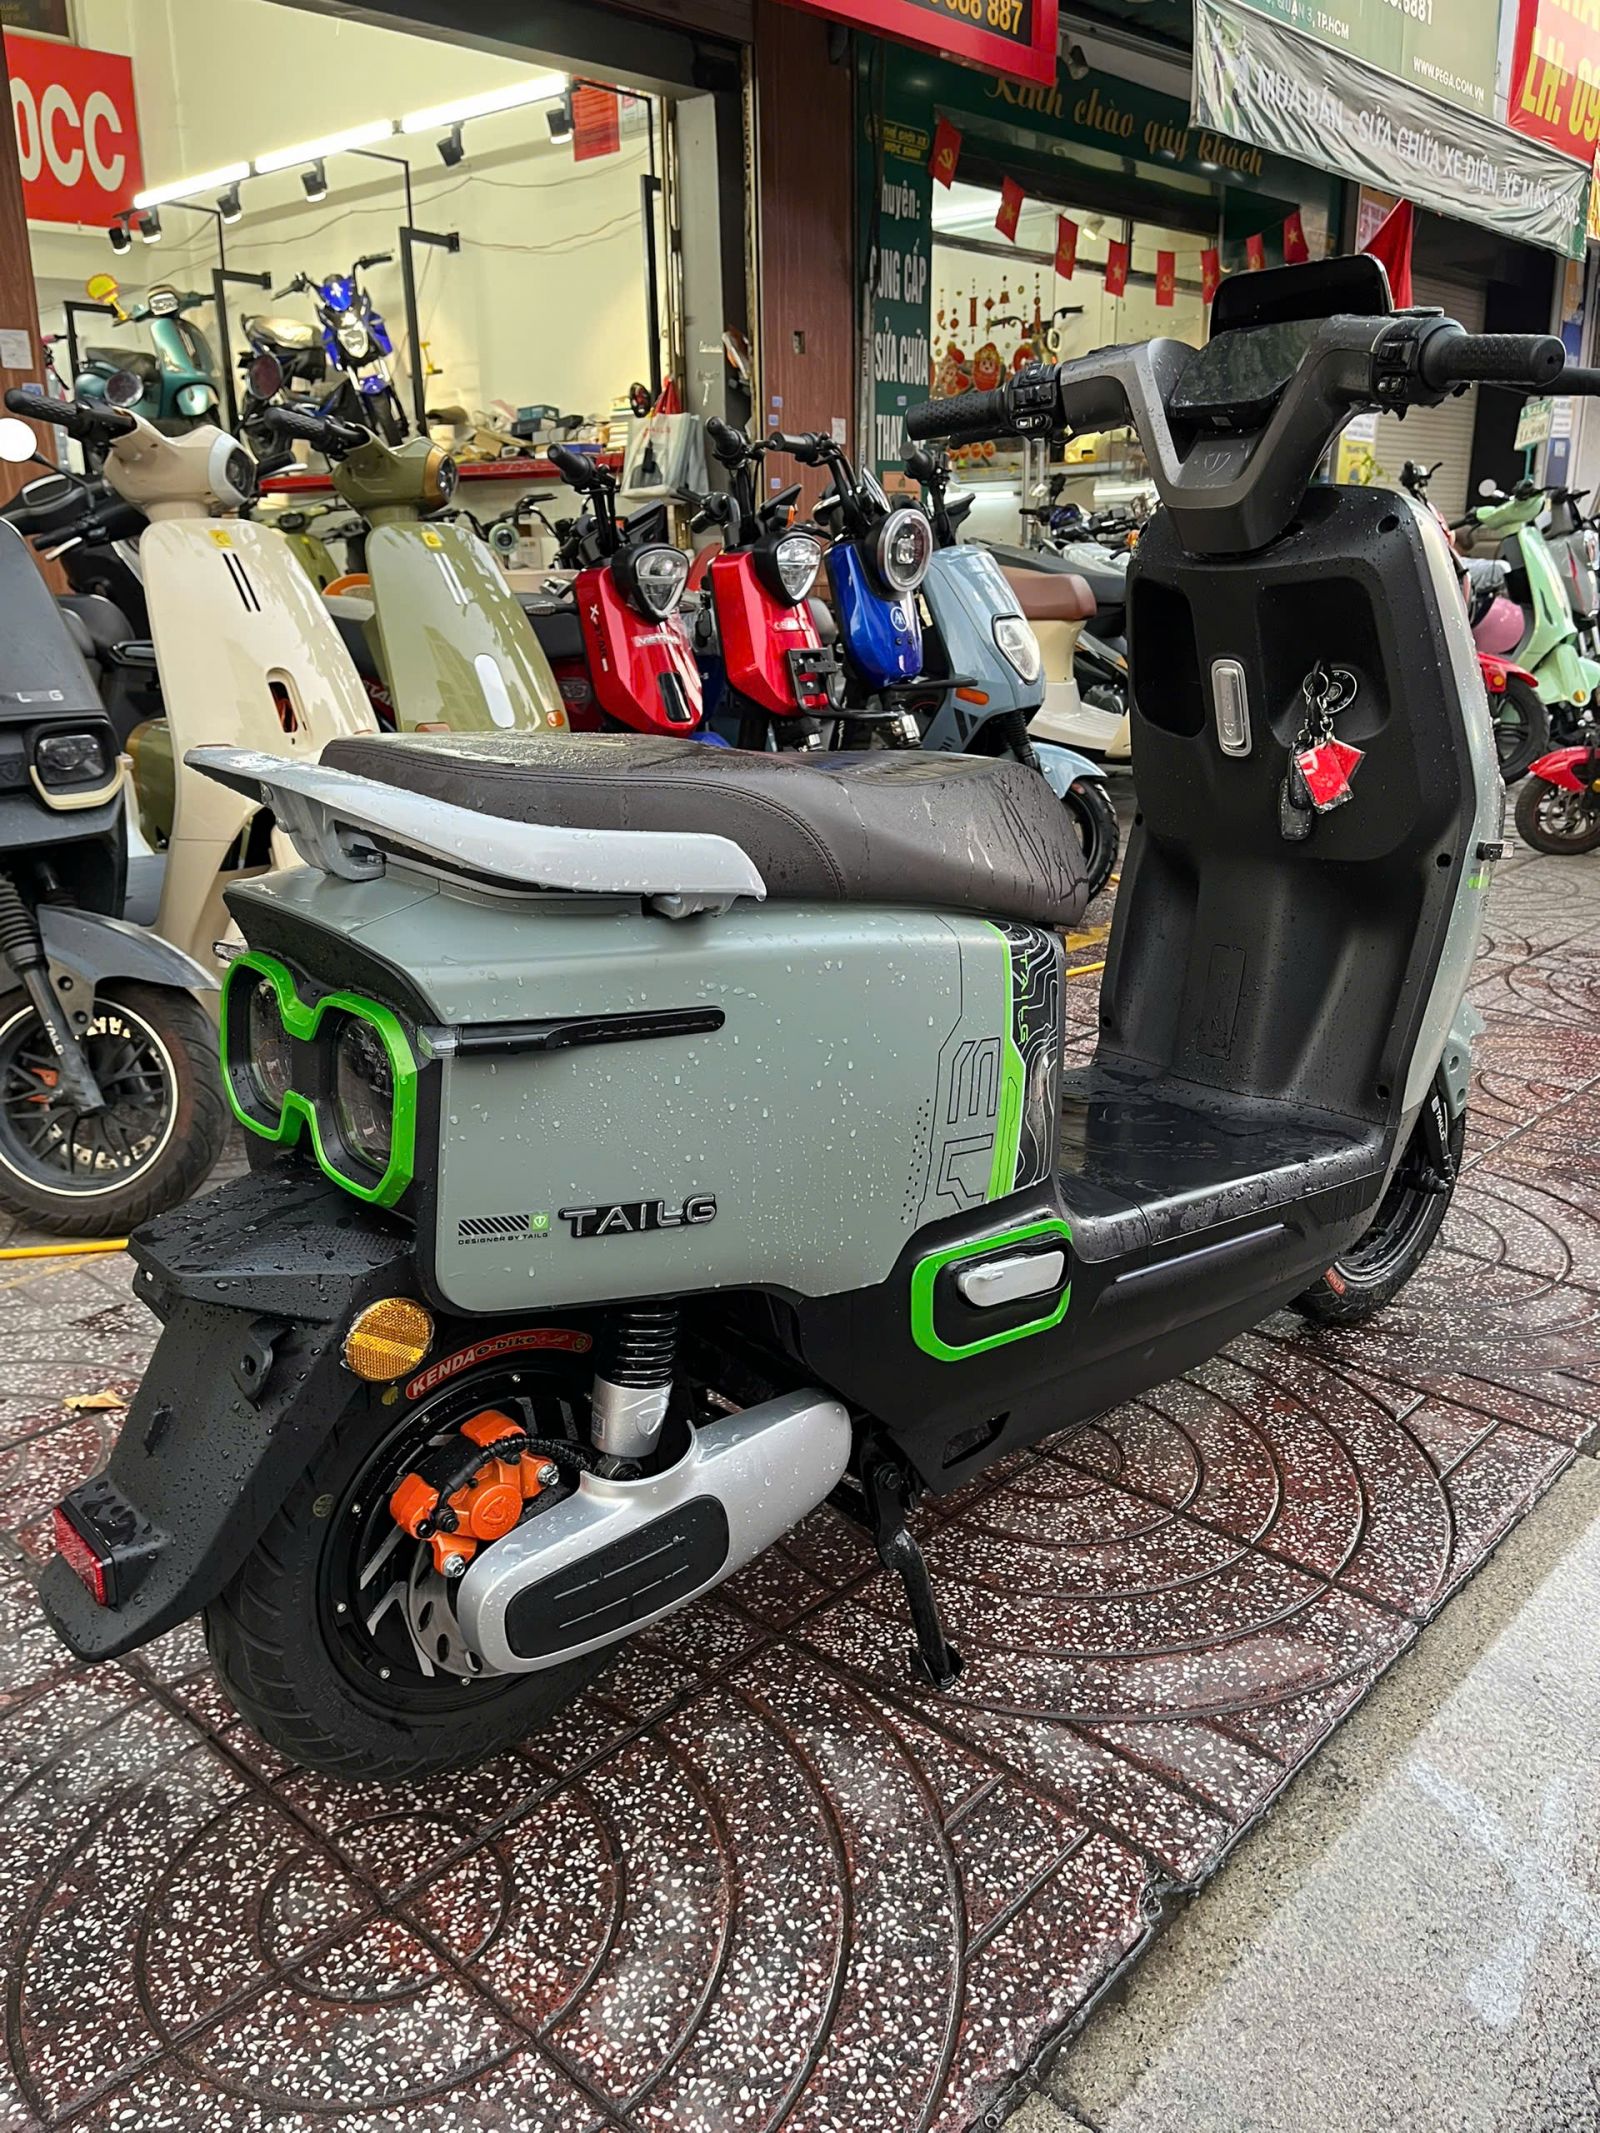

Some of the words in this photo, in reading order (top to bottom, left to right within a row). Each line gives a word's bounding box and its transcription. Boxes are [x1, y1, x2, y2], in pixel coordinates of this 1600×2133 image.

[1317, 10, 1350, 40] TP.HCM
[1412, 55, 1485, 102] WWW.PEGA.COM.VN
[1520, 26, 1569, 126] LH:
[1074, 88, 1134, 138] chào
[1257, 65, 1301, 113] MUA
[1305, 85, 1343, 132] BÁN
[1358, 105, 1391, 152] SỬA
[1396, 126, 1440, 173] CHỮA
[1442, 145, 1464, 177] XE
[1501, 169, 1520, 199] XE
[1520, 177, 1552, 210] MÁY
[881, 175, 920, 220] huyên:
[875, 316, 898, 382] SỬA
[1019, 950, 1030, 1043] TAILG
[458, 1235, 506, 1246] DESIGNER
[562, 1194, 717, 1238] TAILG
[411, 1348, 476, 1397] KENDA
